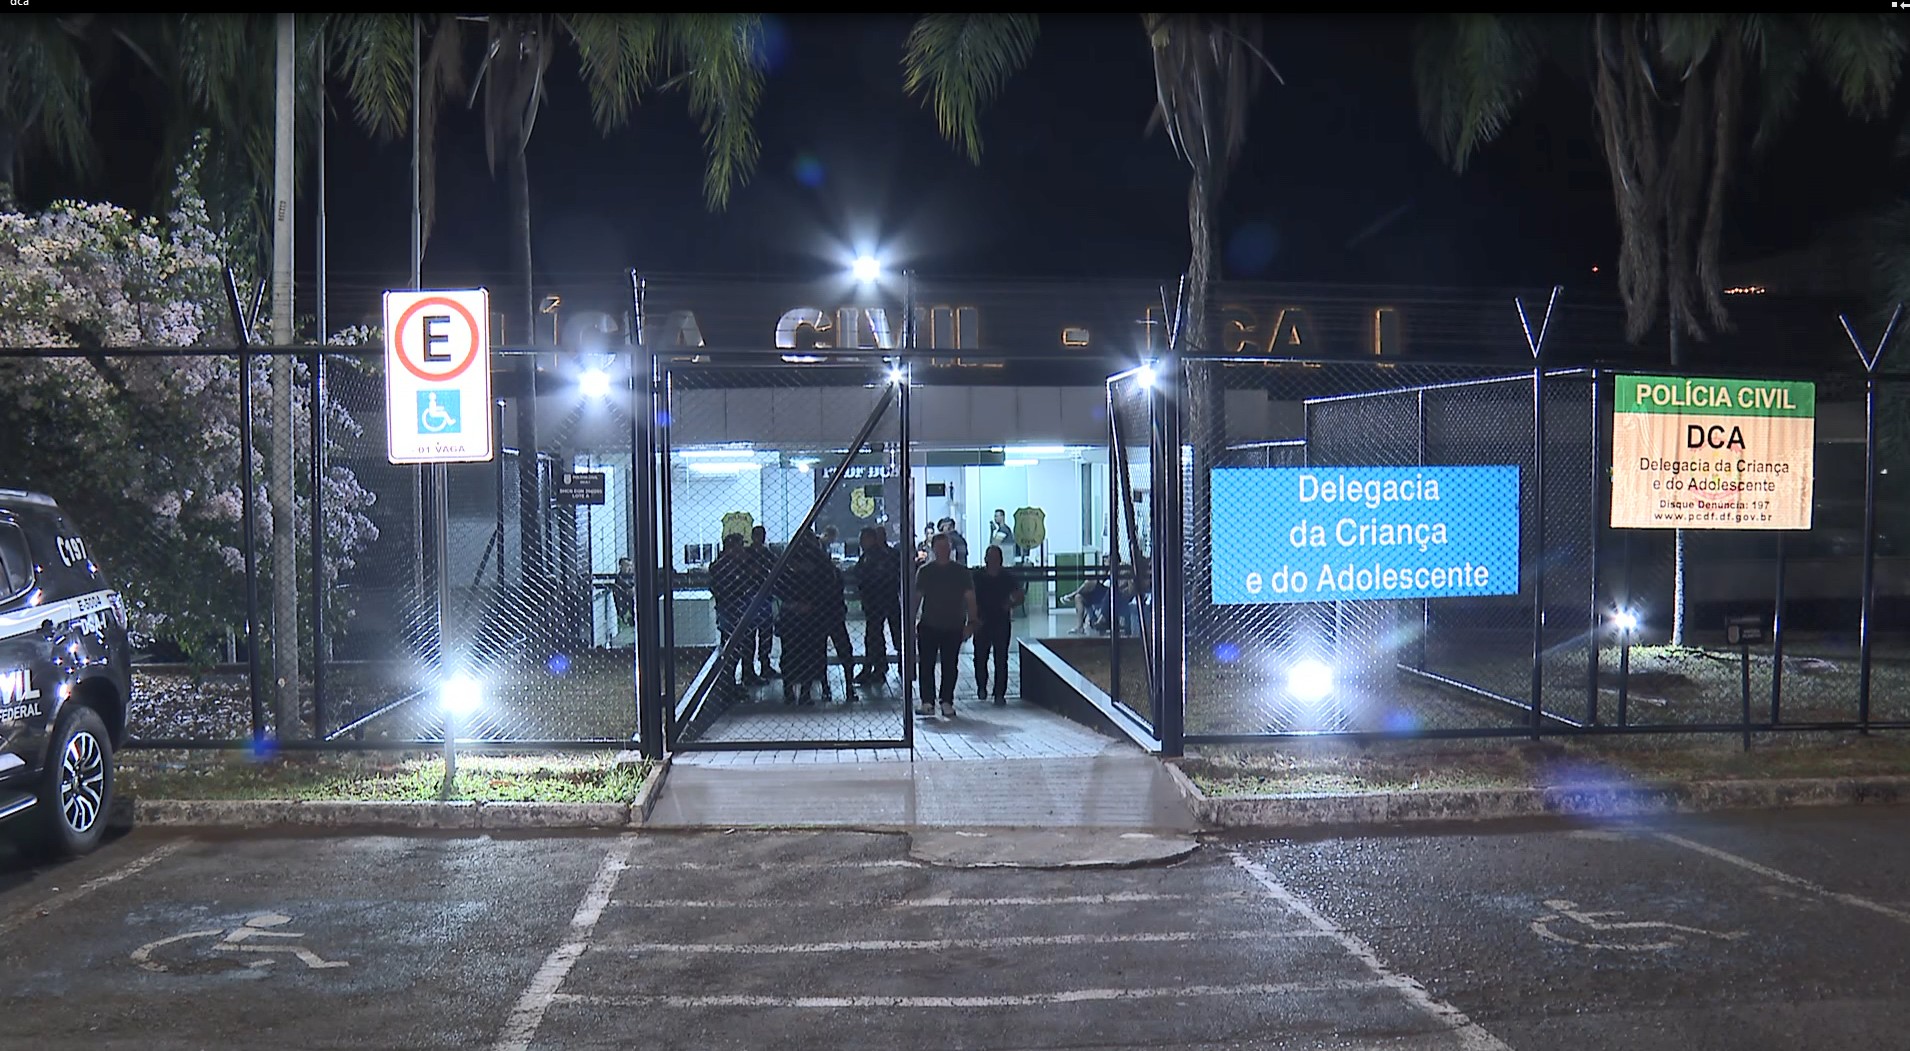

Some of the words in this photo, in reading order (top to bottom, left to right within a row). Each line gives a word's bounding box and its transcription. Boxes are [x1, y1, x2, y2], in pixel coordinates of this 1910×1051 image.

[422, 315, 451, 362] E
[775, 306, 1003, 368] CIVIL
[1636, 380, 1732, 408] POLÍCIA
[1738, 386, 1796, 409] CIVIL
[1686, 424, 1746, 449] DCA
[418, 446, 430, 454] 01
[435, 445, 465, 454] VAGA
[1640, 457, 1710, 475] Delegacia
[1715, 458, 1731, 473] da
[1736, 459, 1790, 477] Criança
[1299, 474, 1440, 509] Delegacia
[1653, 480, 1661, 490] e
[1666, 477, 1683, 491] do
[1687, 478, 1776, 492] Adolescente
[1654, 511, 1773, 523] www.pcdf.df.gov.br
[1659, 500, 1694, 510] Disque
[1698, 500, 1749, 510] Denúncia:
[1752, 501, 1770, 510] 197
[1289, 519, 1327, 548] da
[1336, 518, 1448, 552] Criança
[65, 537, 88, 562] 197
[1246, 572, 1263, 594] e
[1271, 564, 1308, 593] do
[1316, 562, 1489, 593] Adolescente
